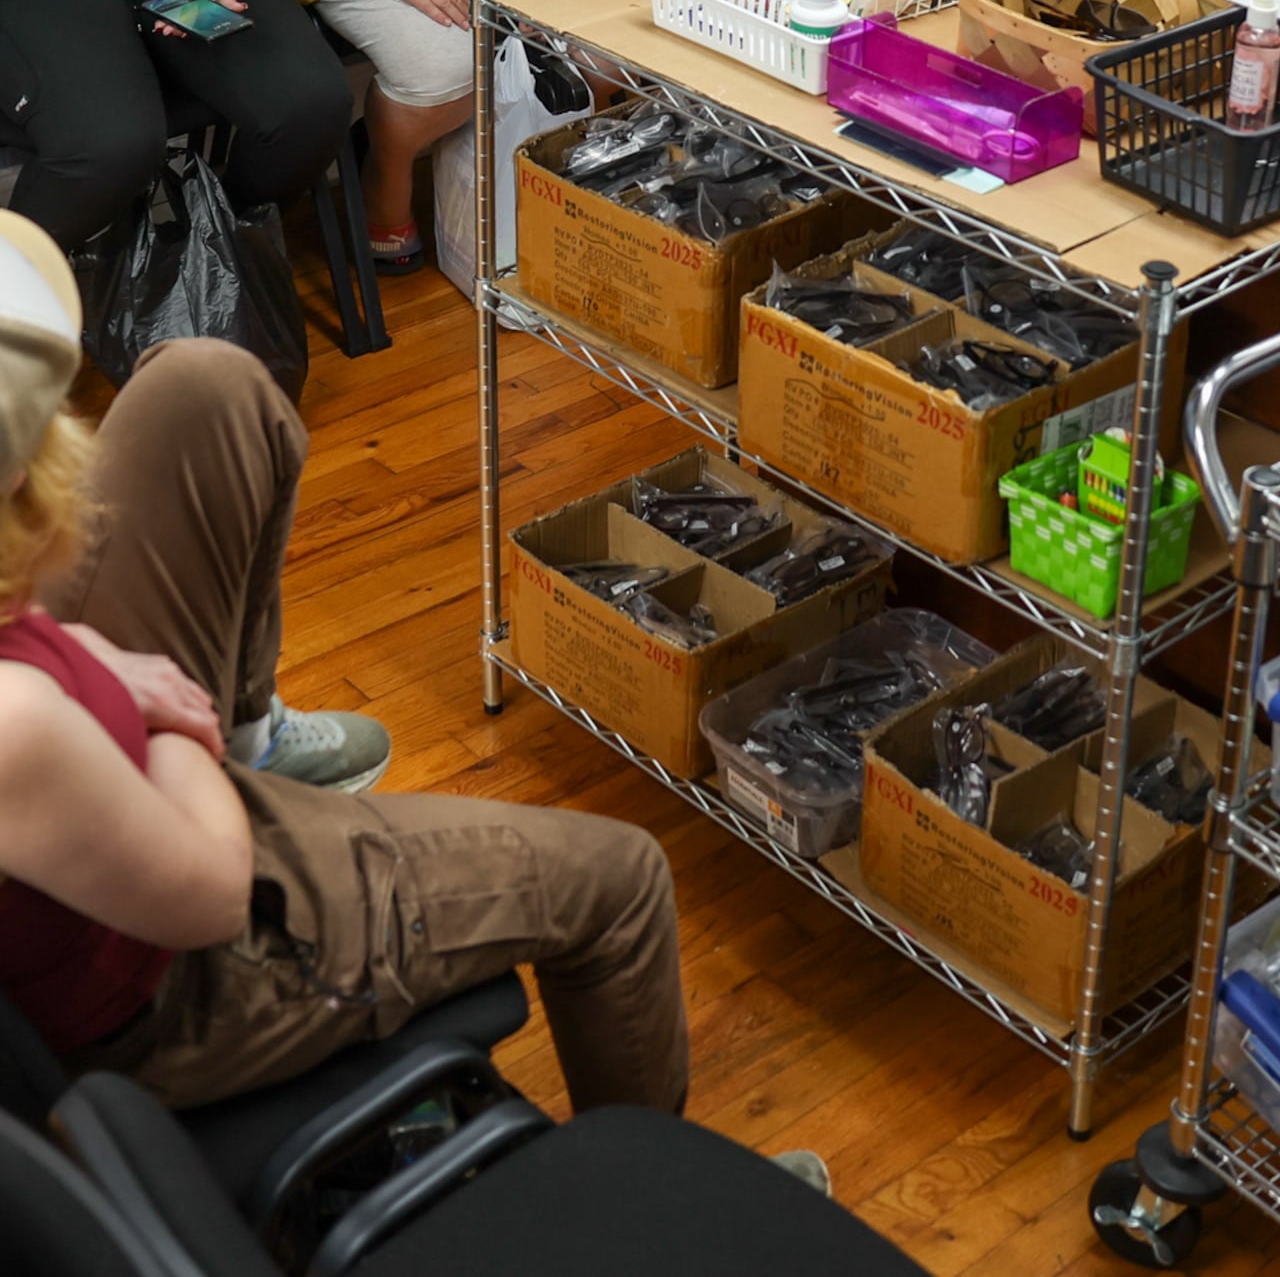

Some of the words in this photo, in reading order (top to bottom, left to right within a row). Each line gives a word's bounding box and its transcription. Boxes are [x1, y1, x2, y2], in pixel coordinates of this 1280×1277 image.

[521, 169, 562, 206] FGXI
[578, 208, 658, 254] RestoringVision
[661, 237, 703, 271] 2025
[746, 313, 798, 359] FGXI
[815, 361, 913, 419] RestoringVision
[917, 400, 966, 441] 2025
[513, 553, 553, 595] FGXI
[643, 639, 682, 674] 2025
[867, 765, 914, 814] FGXI
